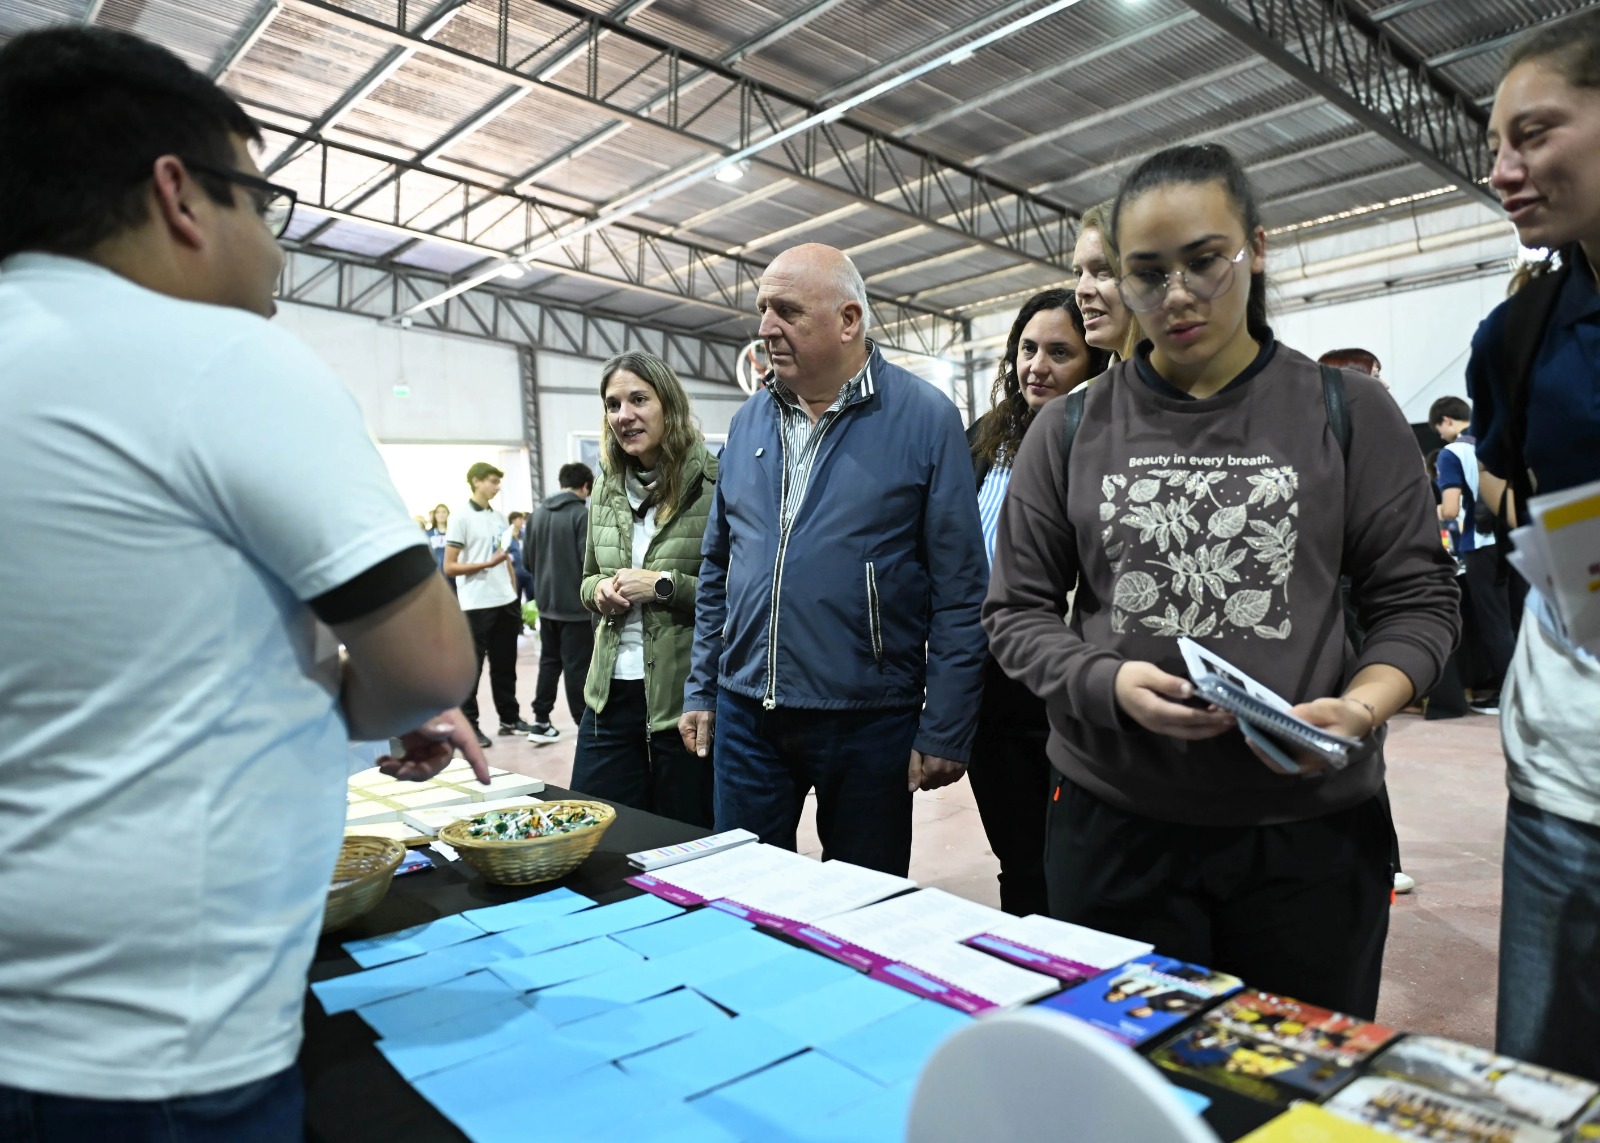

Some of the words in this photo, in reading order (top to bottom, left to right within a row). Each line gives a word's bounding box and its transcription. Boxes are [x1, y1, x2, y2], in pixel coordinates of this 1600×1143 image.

[1129, 454, 1170, 467] Beauty
[1174, 453, 1185, 464] in
[1189, 455, 1224, 468] every
[1227, 454, 1273, 466] breath.
